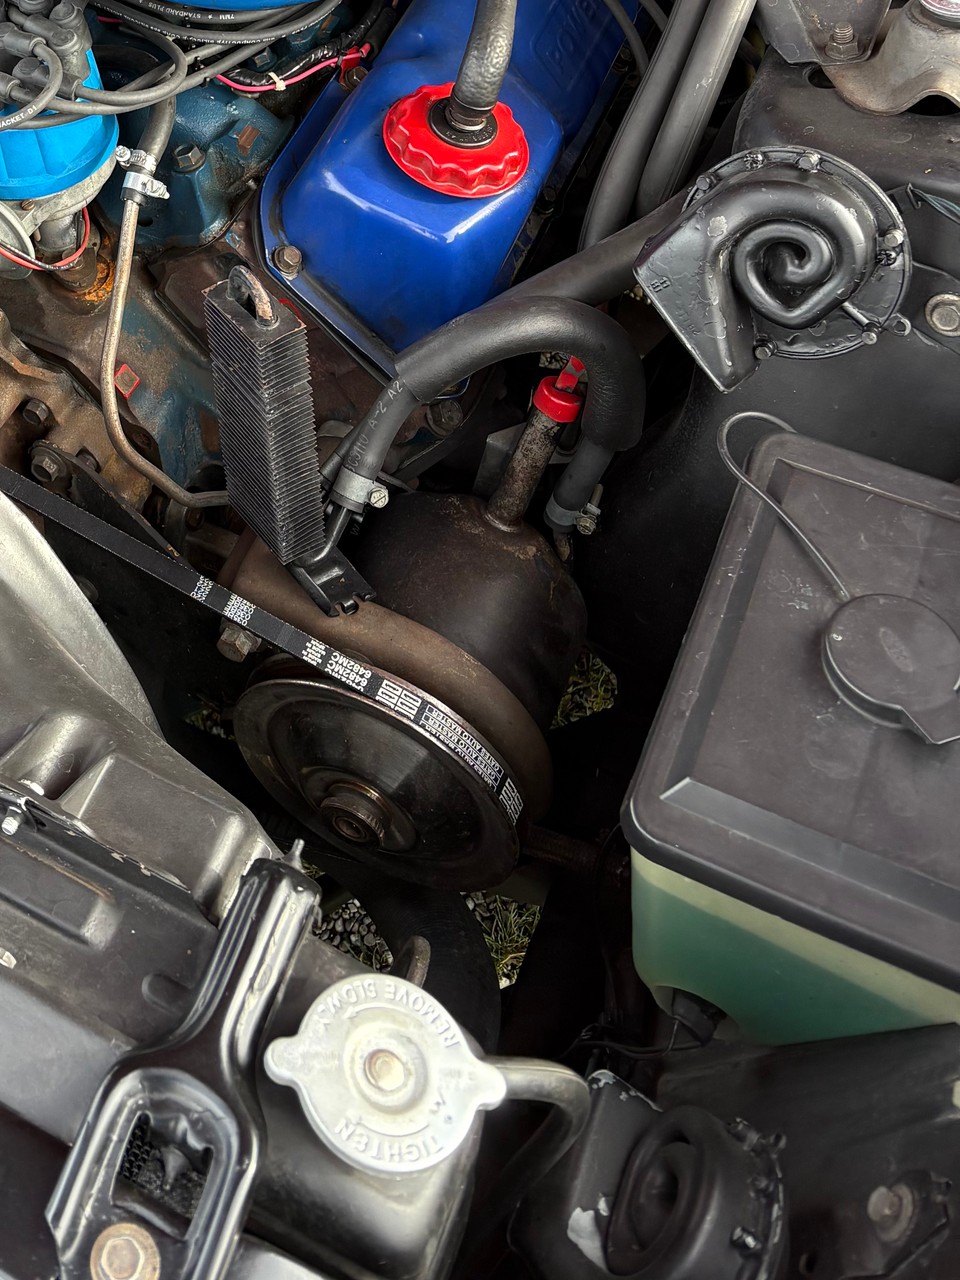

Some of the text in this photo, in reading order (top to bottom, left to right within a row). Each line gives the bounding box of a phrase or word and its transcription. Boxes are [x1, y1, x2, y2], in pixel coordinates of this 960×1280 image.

[147, 1, 165, 13] PLUS
[326, 660, 368, 687] 6482MC
[330, 652, 372, 679] 6482MC
[429, 717, 496, 780] GATES AUTO MASTER
[432, 709, 500, 771] GATES AUTO MASTER
[383, 979, 460, 1049] REMOVE
[335, 1117, 445, 1163] TIGHTEN
